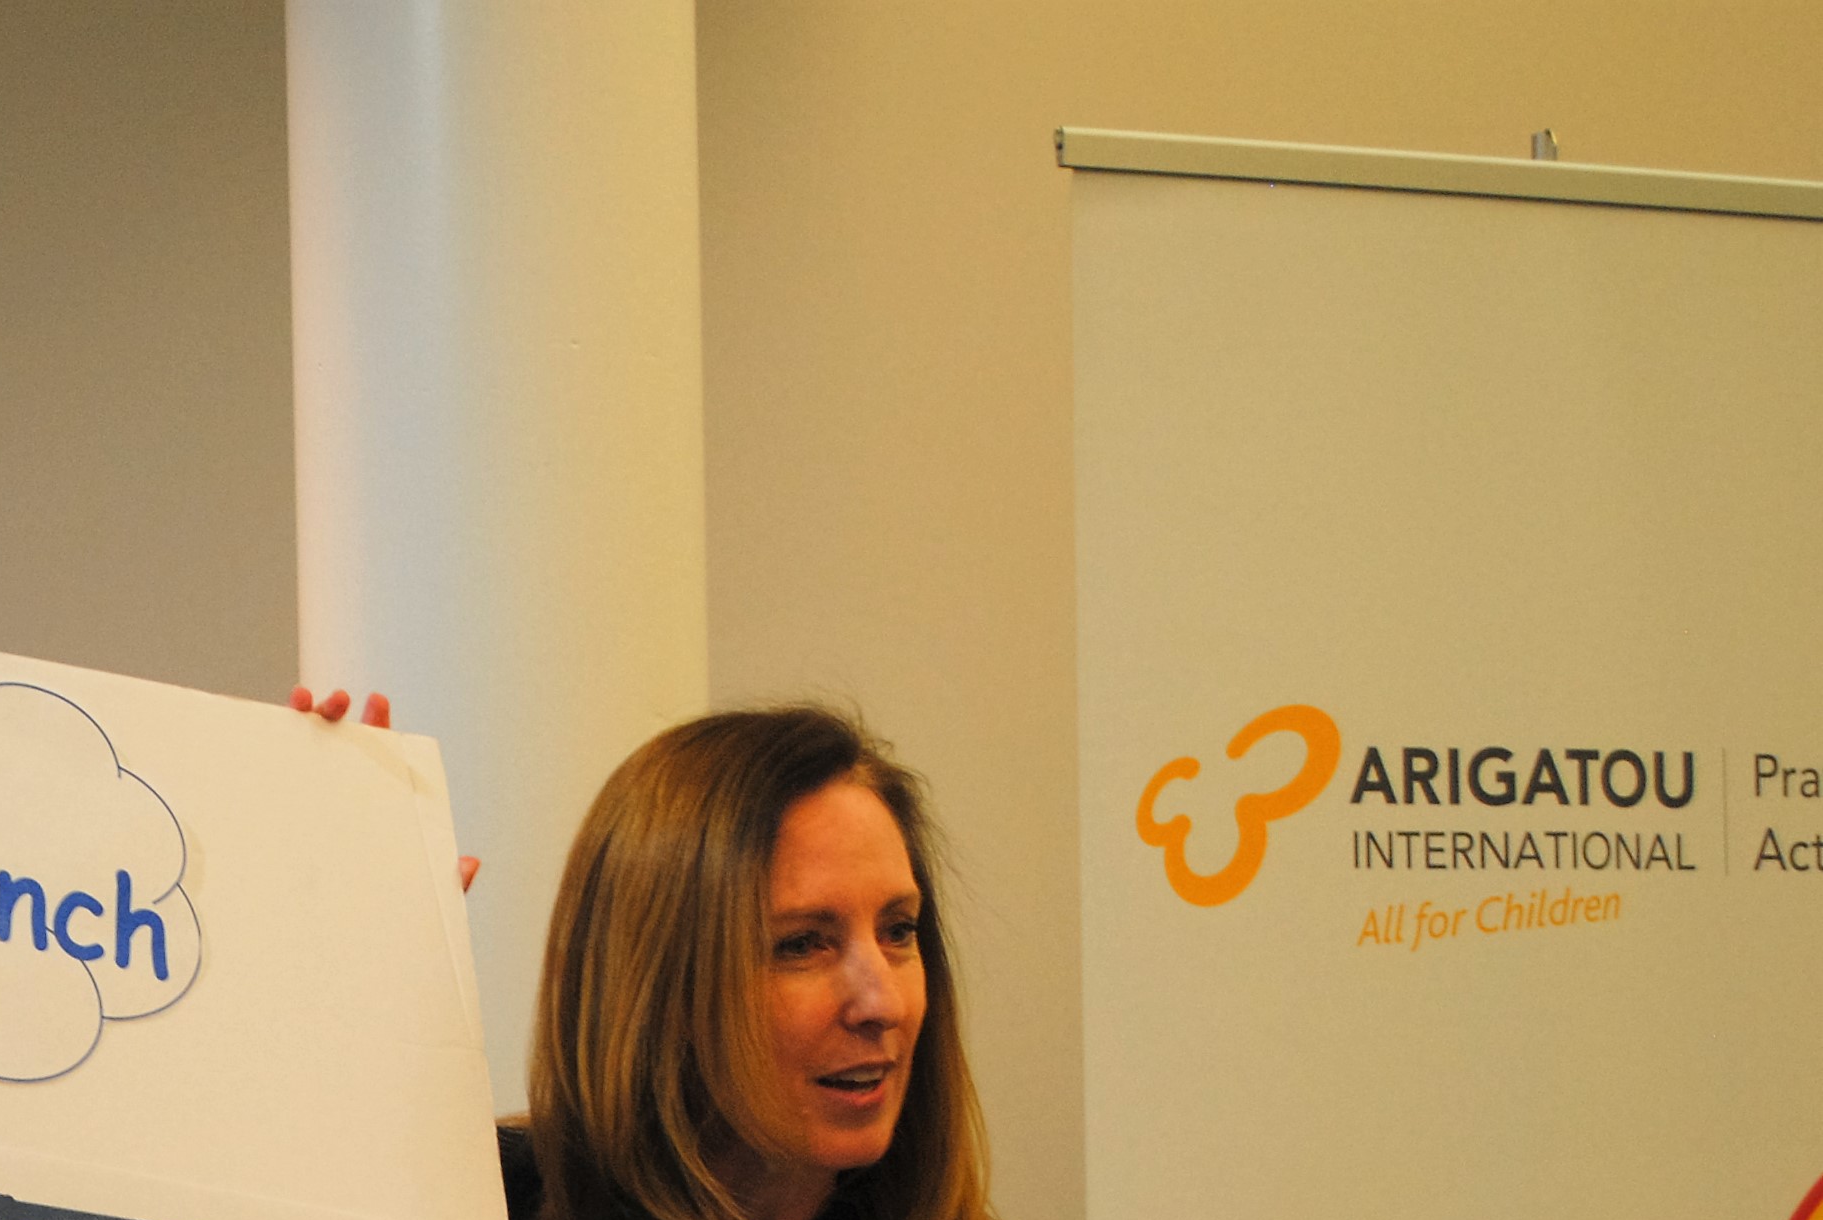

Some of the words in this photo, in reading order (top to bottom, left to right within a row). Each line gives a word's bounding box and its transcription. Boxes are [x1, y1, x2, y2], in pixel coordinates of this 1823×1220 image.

[1350, 746, 1695, 808] ARIGATOU
[1753, 753, 1821, 798] Pra
[1351, 830, 1696, 871] INTERNATIONAL
[1357, 903, 1405, 947] All
[1409, 901, 1467, 952] for
[1476, 886, 1622, 934] Children
